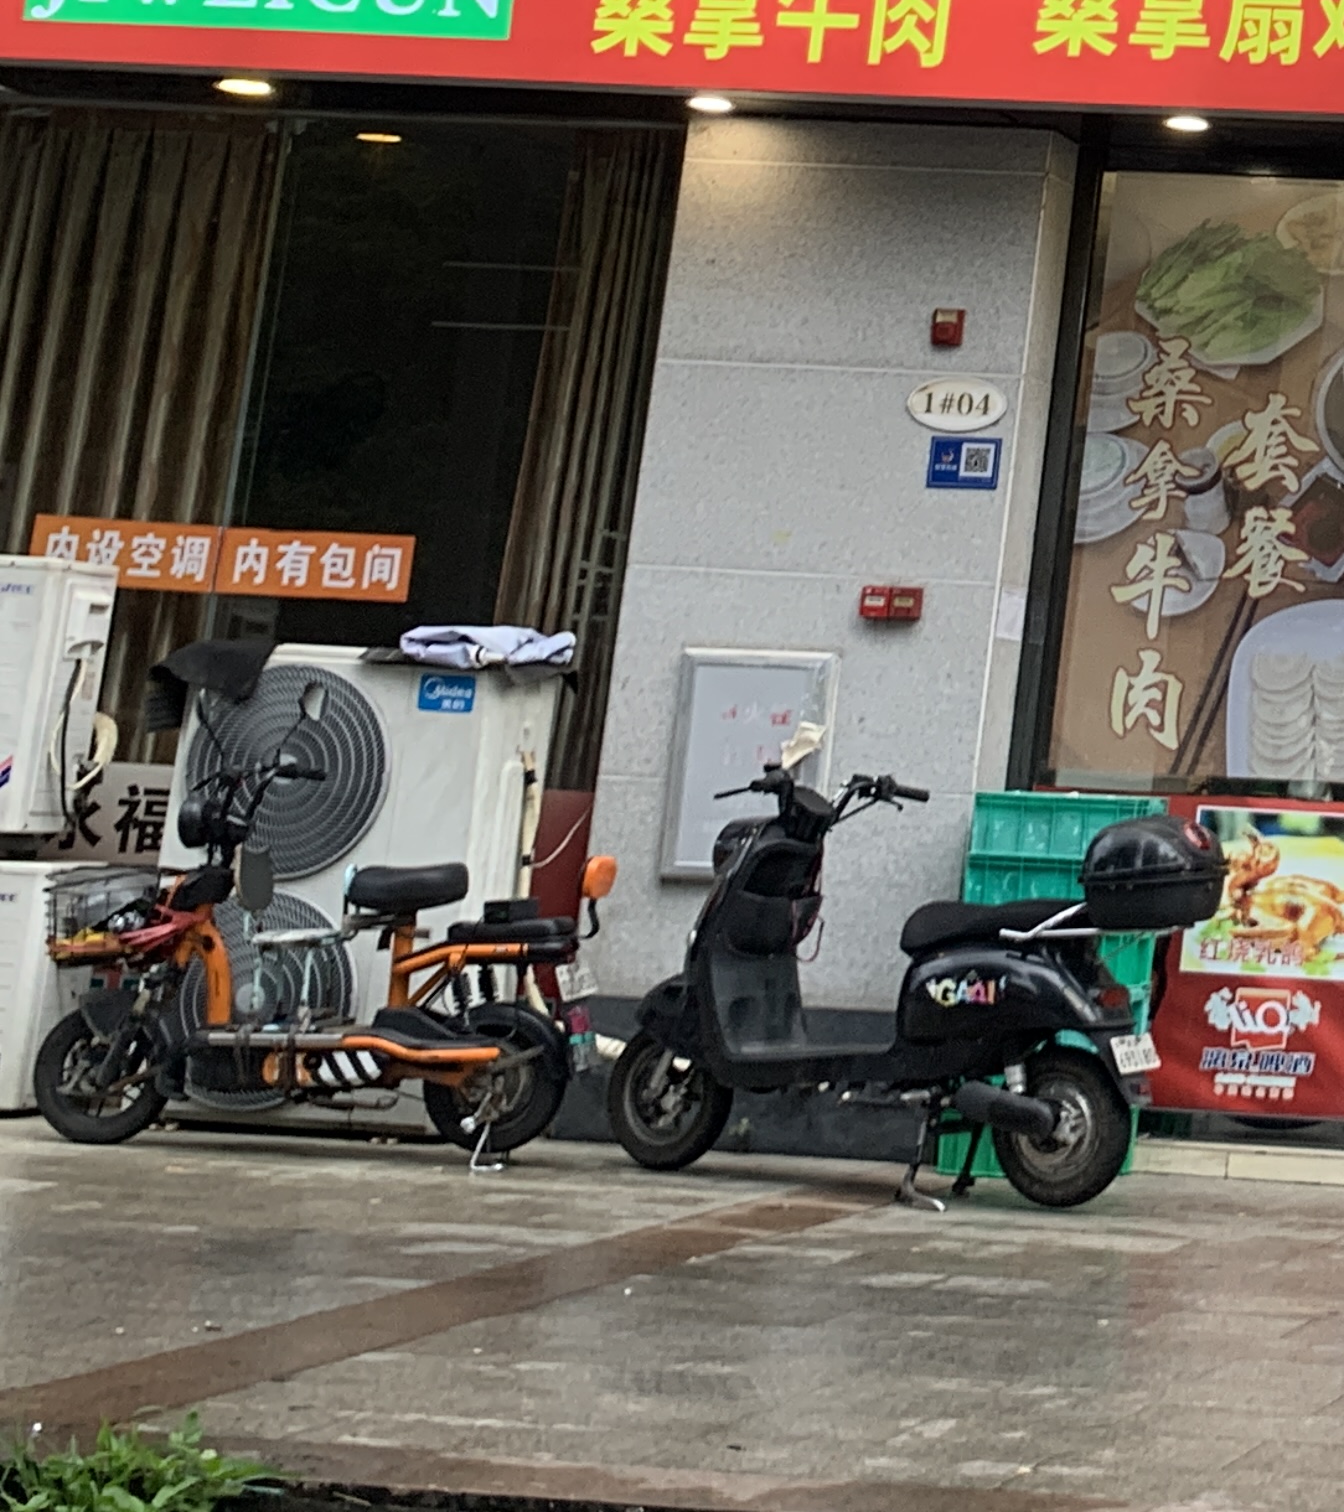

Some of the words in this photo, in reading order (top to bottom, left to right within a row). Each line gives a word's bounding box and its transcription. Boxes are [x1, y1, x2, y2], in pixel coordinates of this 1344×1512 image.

[924, 392, 990, 417] 1#04
[45, 525, 211, 582] 内设空调
[233, 537, 402, 591] 内有包间
[1110, 339, 1214, 751] 桑拿牛肉
[1222, 392, 1320, 599] 套餐
